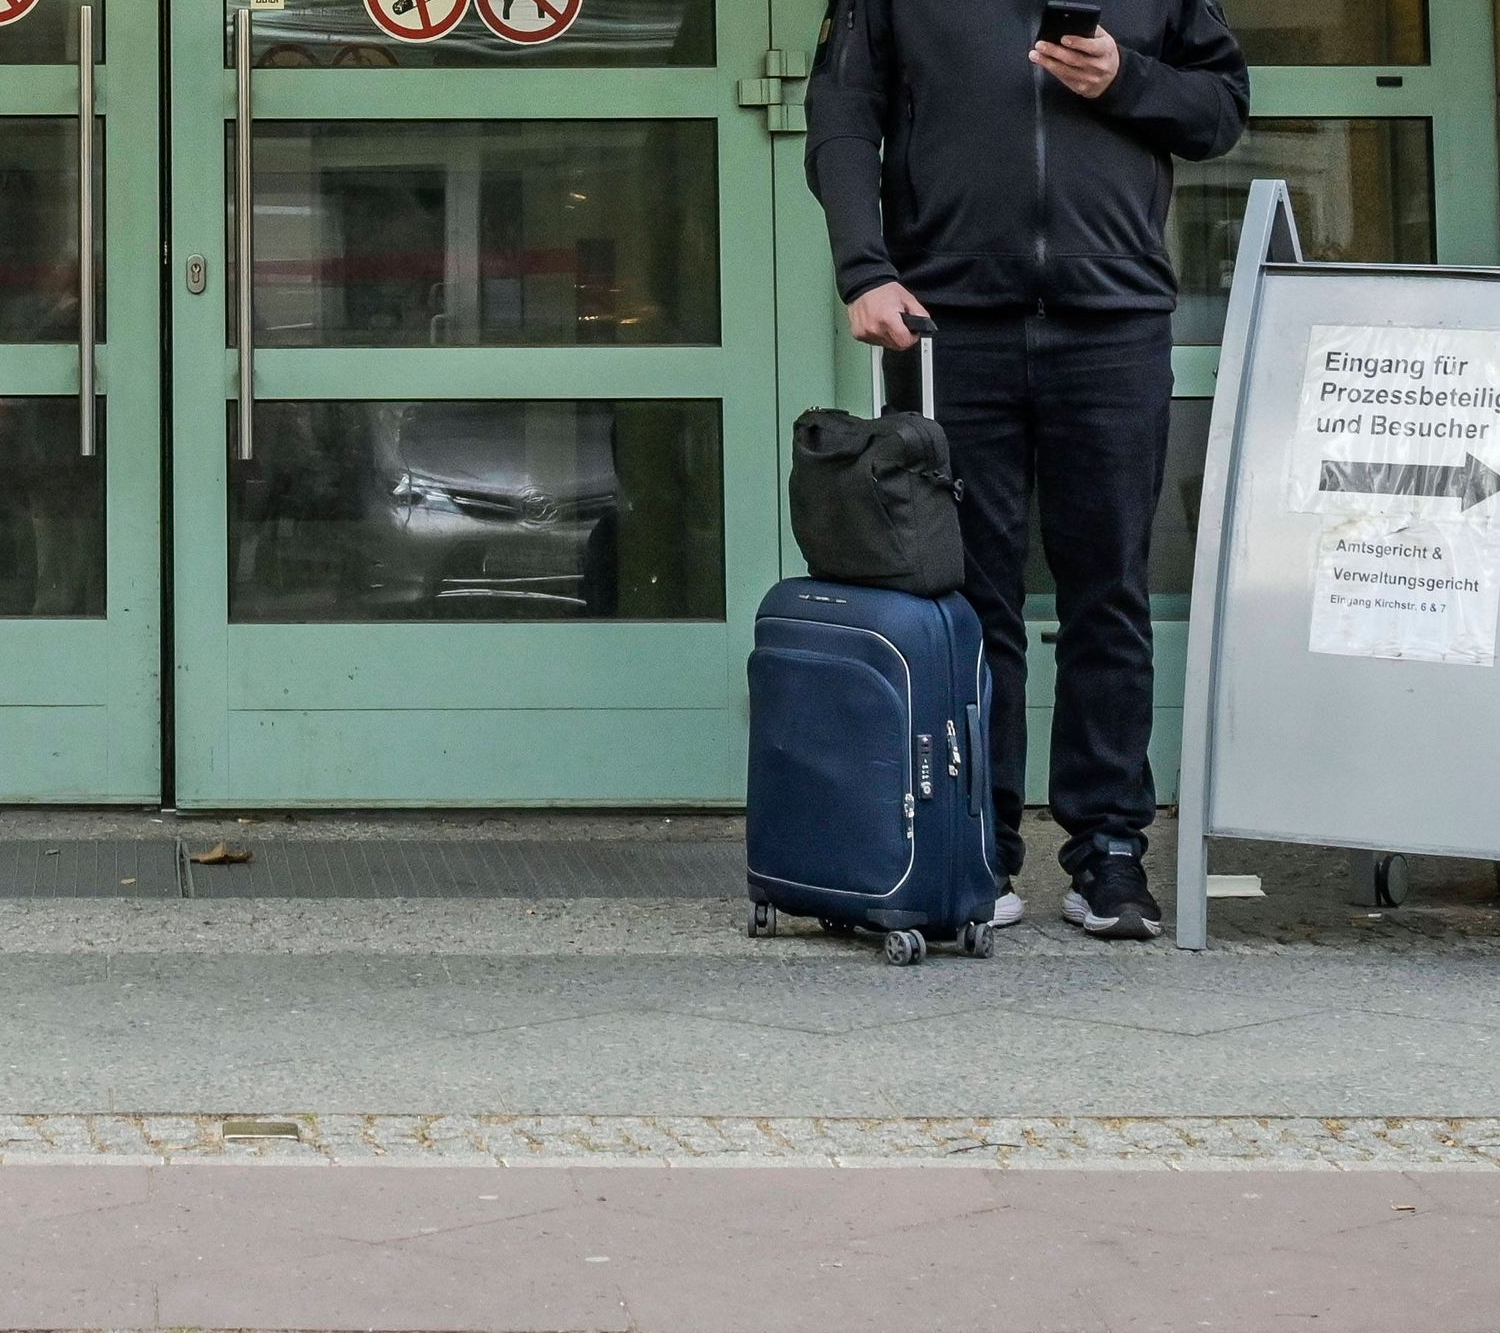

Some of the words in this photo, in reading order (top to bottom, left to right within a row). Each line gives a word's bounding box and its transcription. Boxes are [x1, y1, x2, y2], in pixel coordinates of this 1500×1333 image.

[1325, 351, 1424, 379] Eingang
[1434, 355, 1468, 376] für
[1316, 414, 1362, 435] und
[1370, 415, 1489, 439] Besucher
[1335, 539, 1427, 559] Amtsgericht
[1432, 546, 1442, 560] &
[1333, 567, 1479, 592] Verwaltungsgericht
[1374, 598, 1417, 611] Kirchstr.
[1420, 602, 1427, 612] 6
[1429, 603, 1437, 613] &
[1440, 604, 1447, 613] 7
